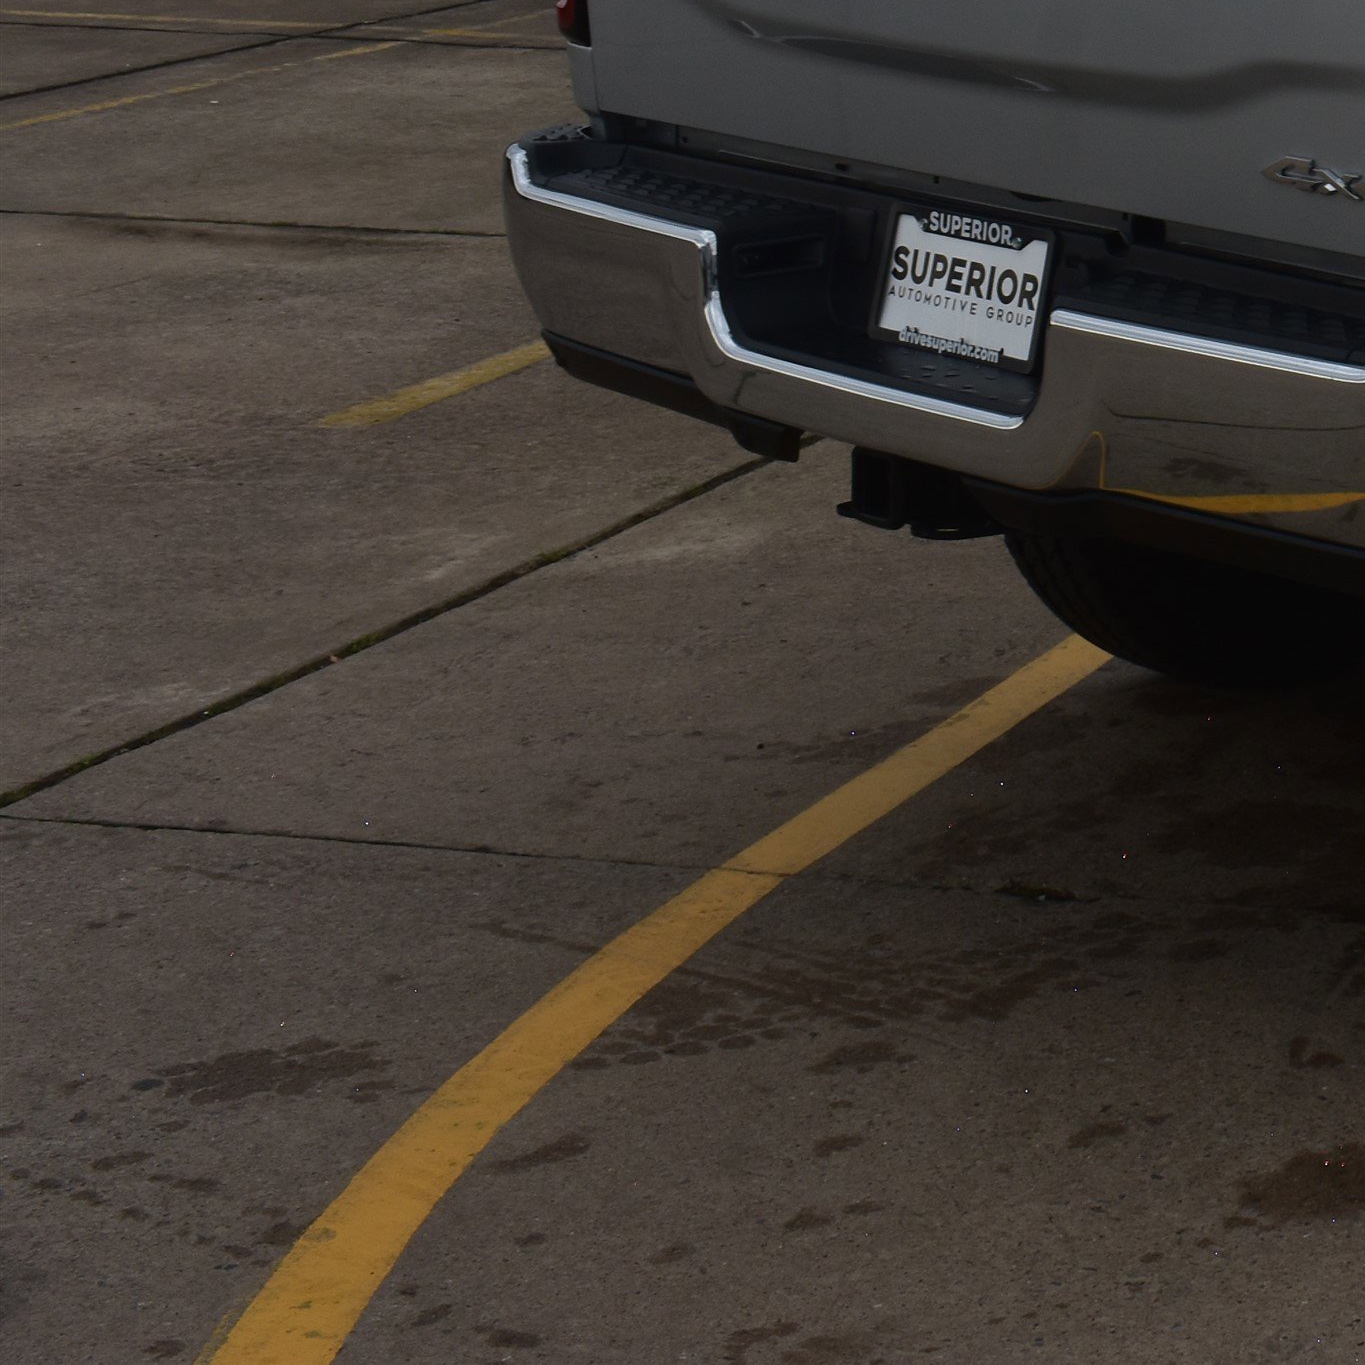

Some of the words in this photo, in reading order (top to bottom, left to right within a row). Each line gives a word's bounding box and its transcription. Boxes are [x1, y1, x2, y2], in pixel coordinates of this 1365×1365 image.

[929, 211, 1013, 246] SUPERIOR
[891, 245, 1039, 311] SUPERIOR
[887, 285, 977, 316] AUTOMOTIVE
[986, 306, 1033, 328] GROUP
[899, 325, 1000, 364] drivesuperior.com
